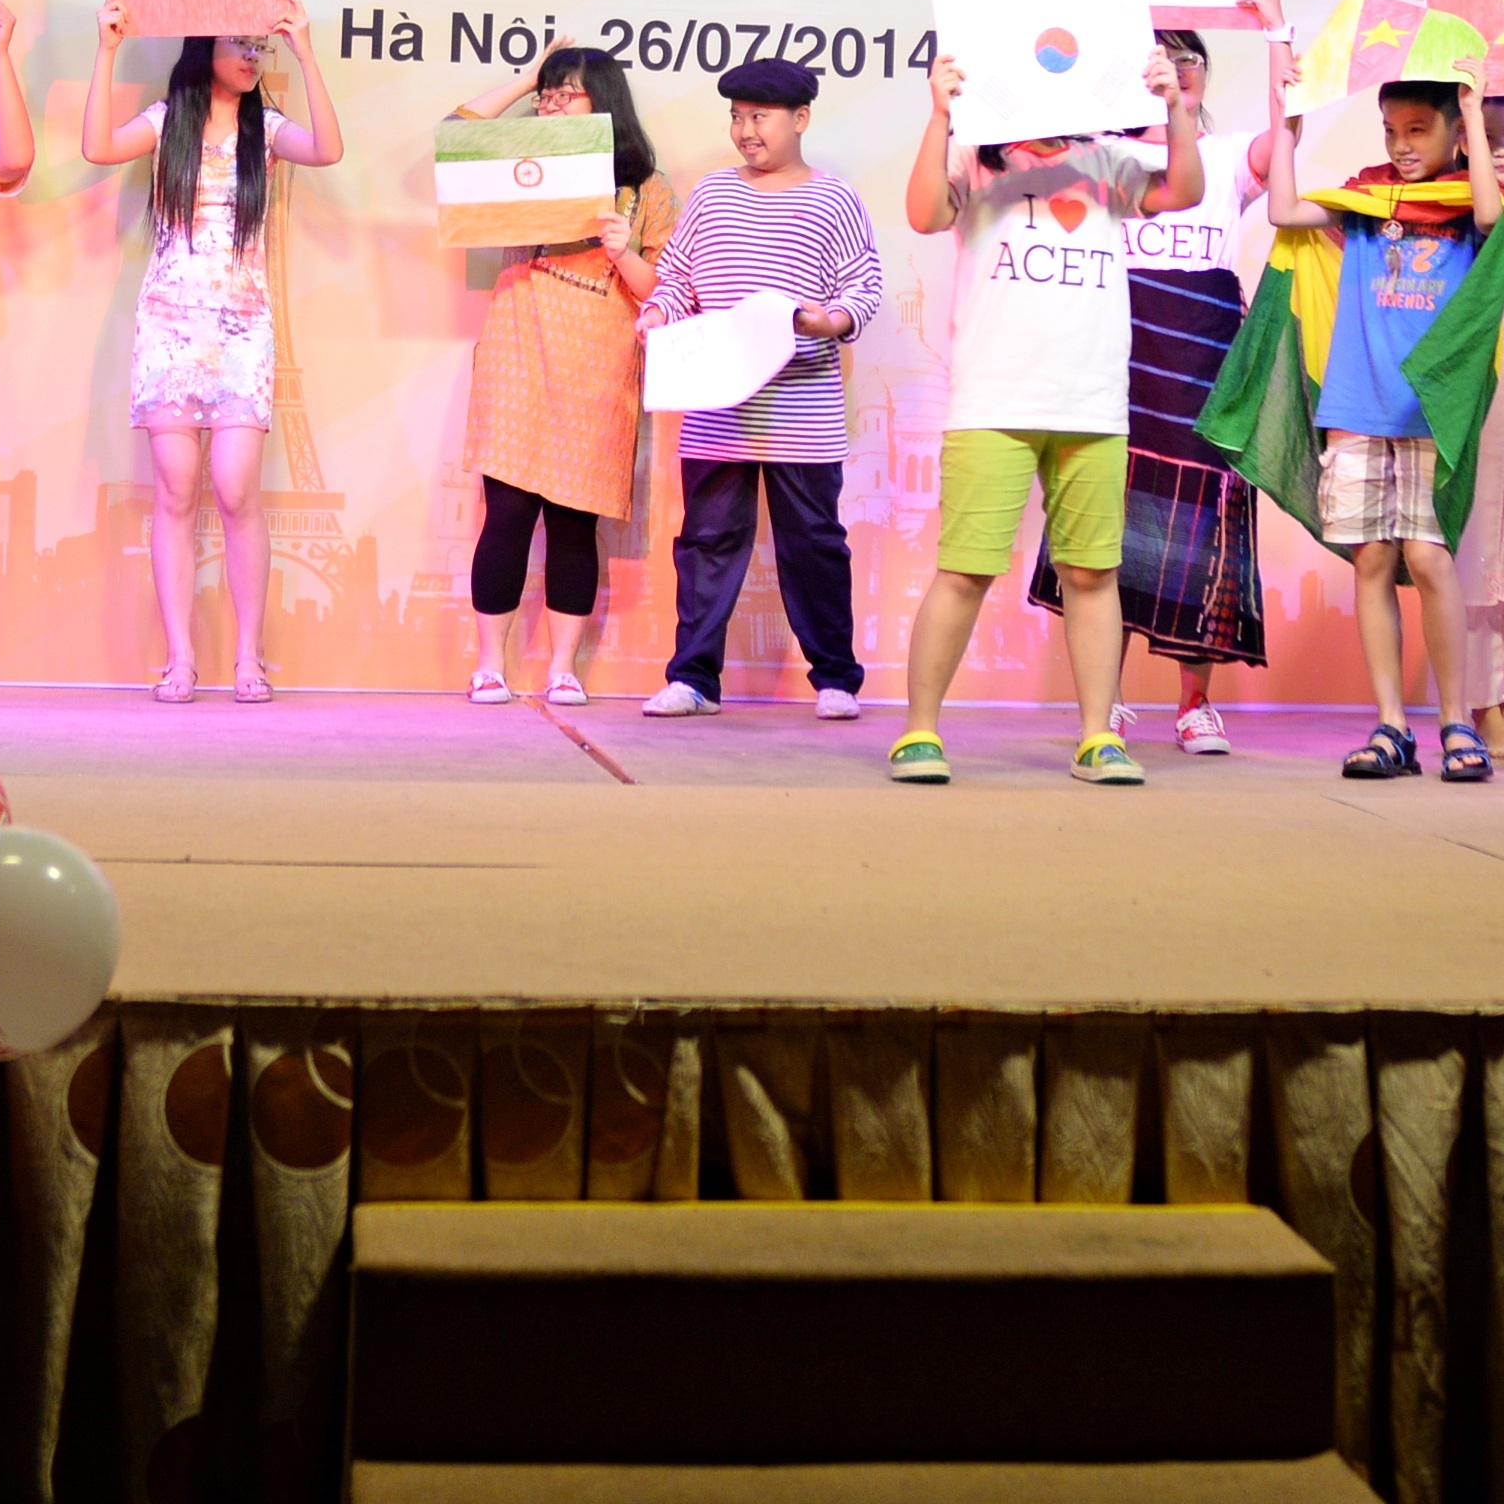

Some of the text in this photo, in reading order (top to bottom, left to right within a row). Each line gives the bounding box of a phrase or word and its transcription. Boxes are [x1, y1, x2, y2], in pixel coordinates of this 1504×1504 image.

[340, 6, 425, 63] Hà
[600, 17, 938, 79] 26/07/2014
[1023, 193, 1037, 230] I
[990, 241, 1115, 289] ACET
